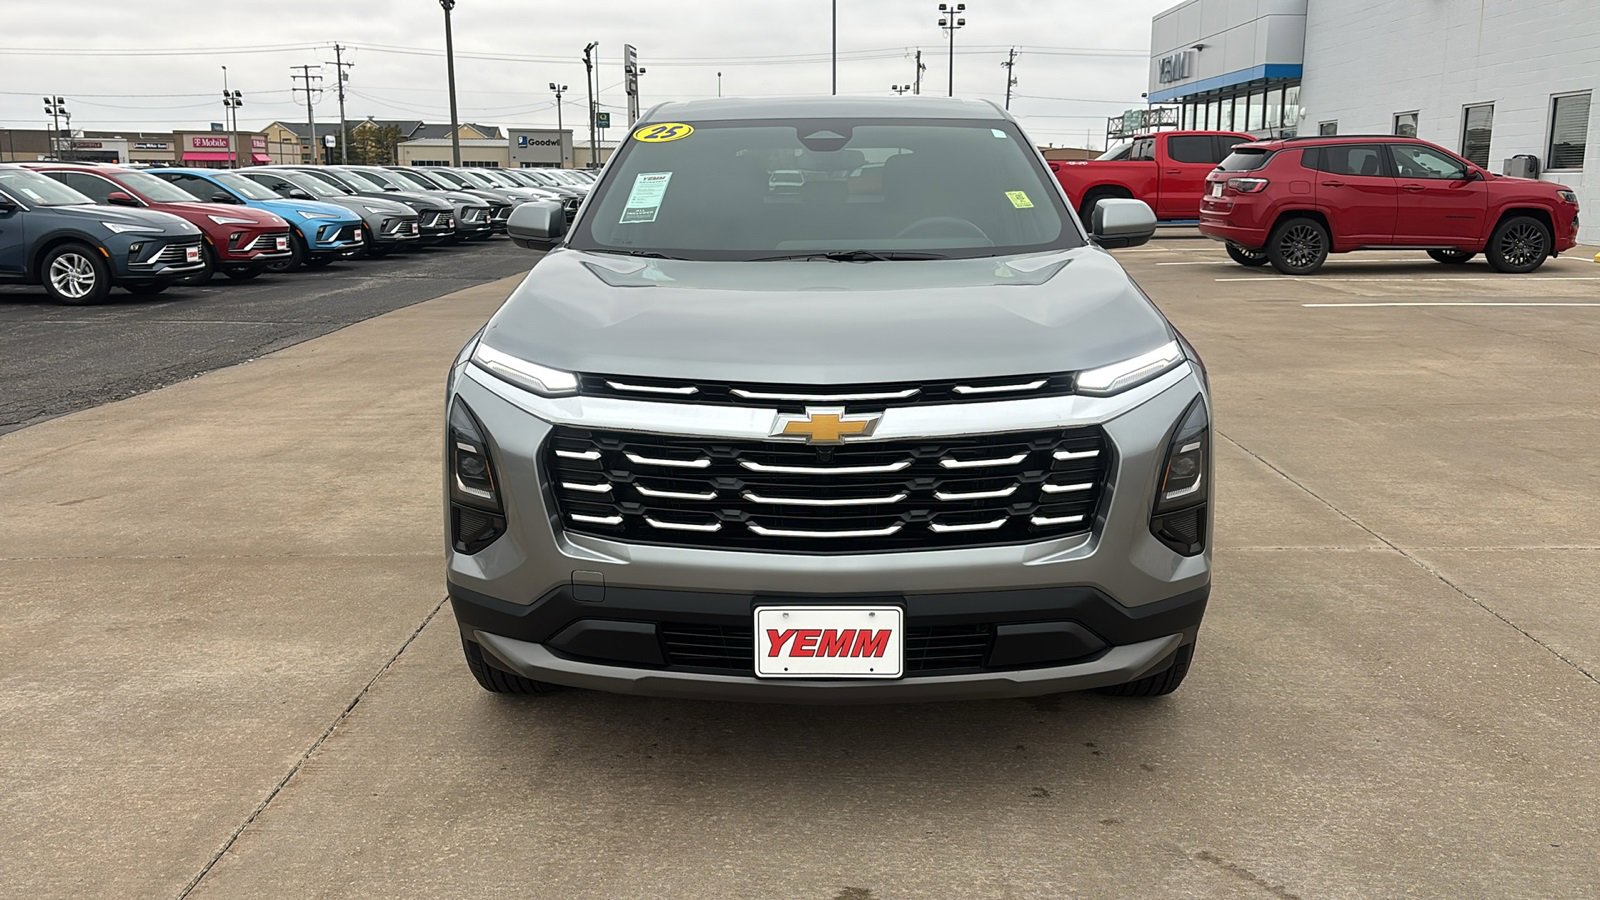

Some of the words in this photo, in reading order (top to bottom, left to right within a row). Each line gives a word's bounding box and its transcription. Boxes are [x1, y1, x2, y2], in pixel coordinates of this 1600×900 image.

[644, 125, 684, 139] 25
[202, 138, 227, 147] Mobile
[766, 629, 893, 658] YEMM
